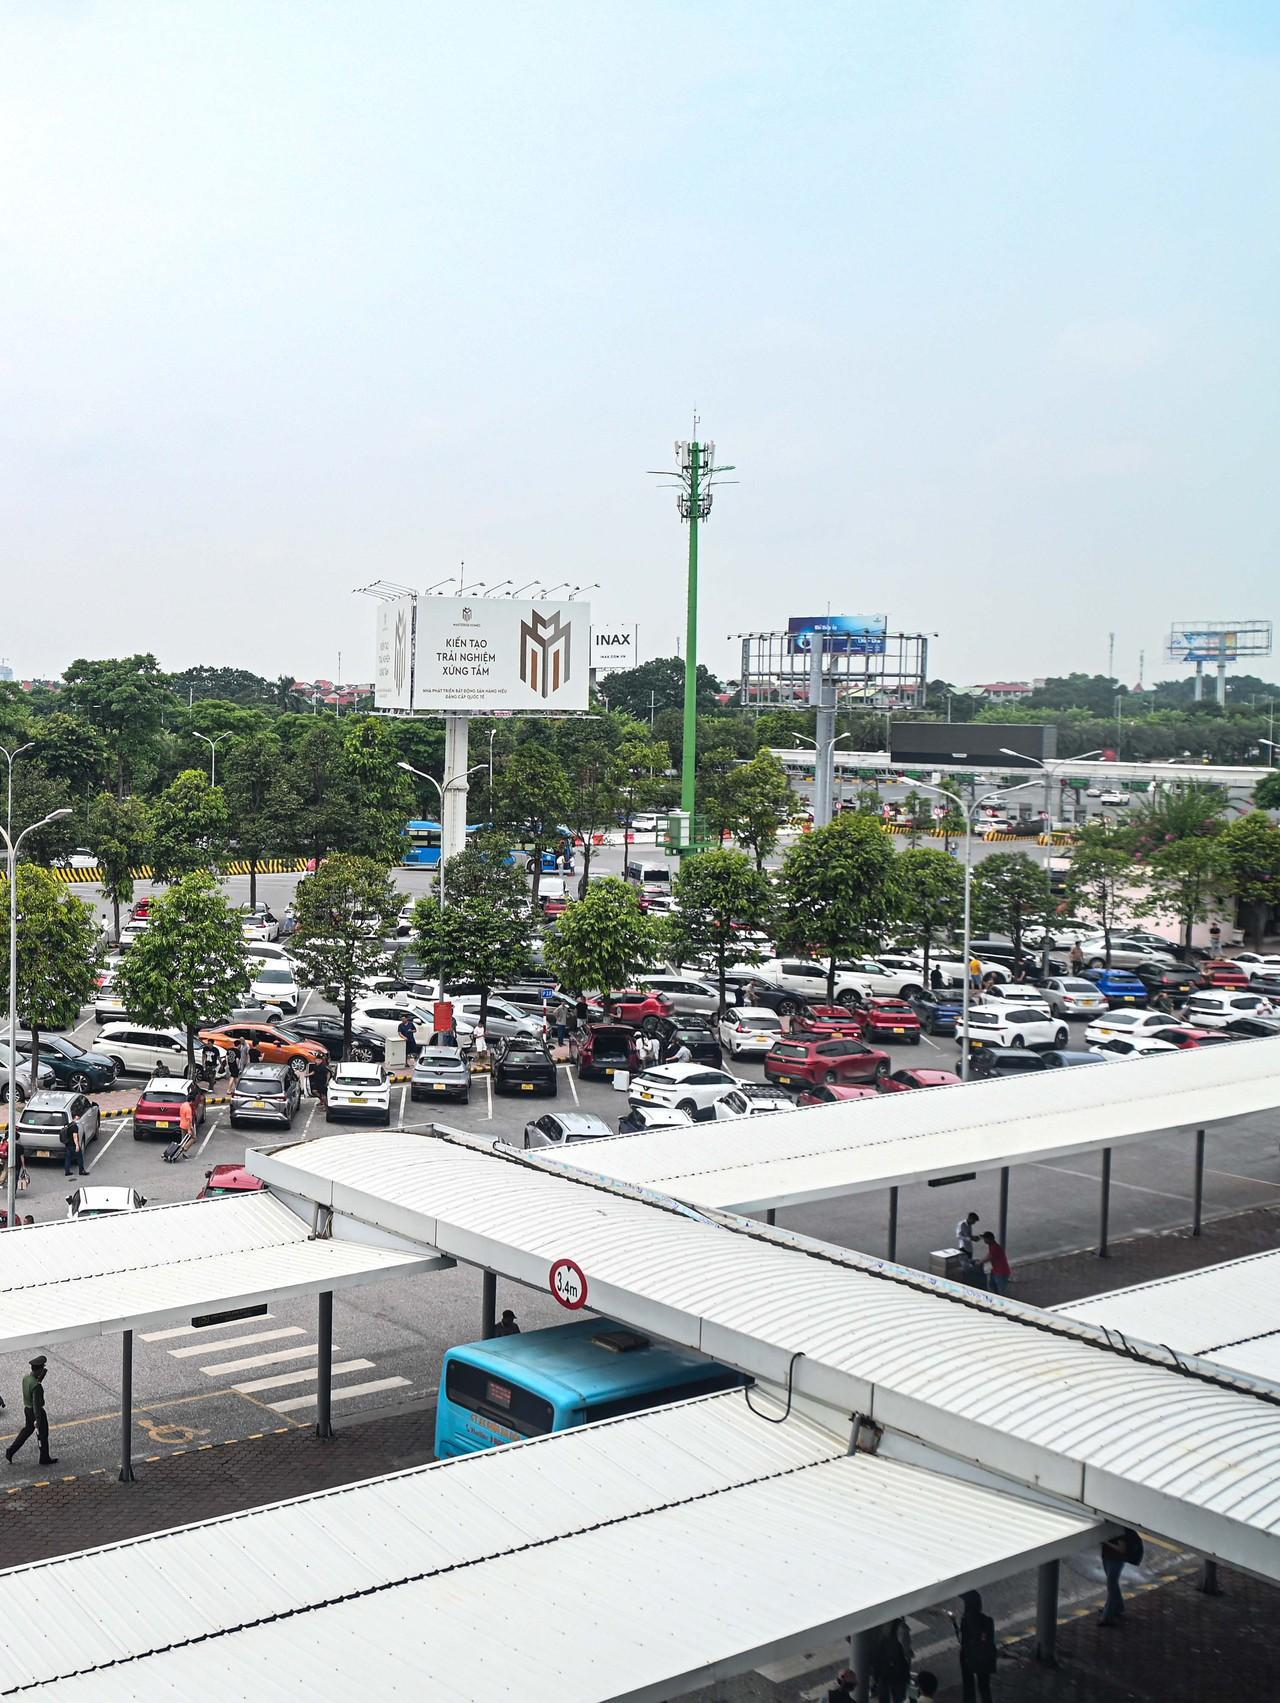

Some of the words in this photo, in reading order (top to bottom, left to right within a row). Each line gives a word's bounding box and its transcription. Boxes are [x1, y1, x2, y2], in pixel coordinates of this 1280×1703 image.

[446, 635, 467, 648] KIẾN
[469, 639, 488, 651] TẠO
[596, 634, 631, 646] INAX
[460, 651, 496, 665] NGHIỆM
[442, 664, 469, 676] XỨNG
[557, 1271, 578, 1298] 3.4m
